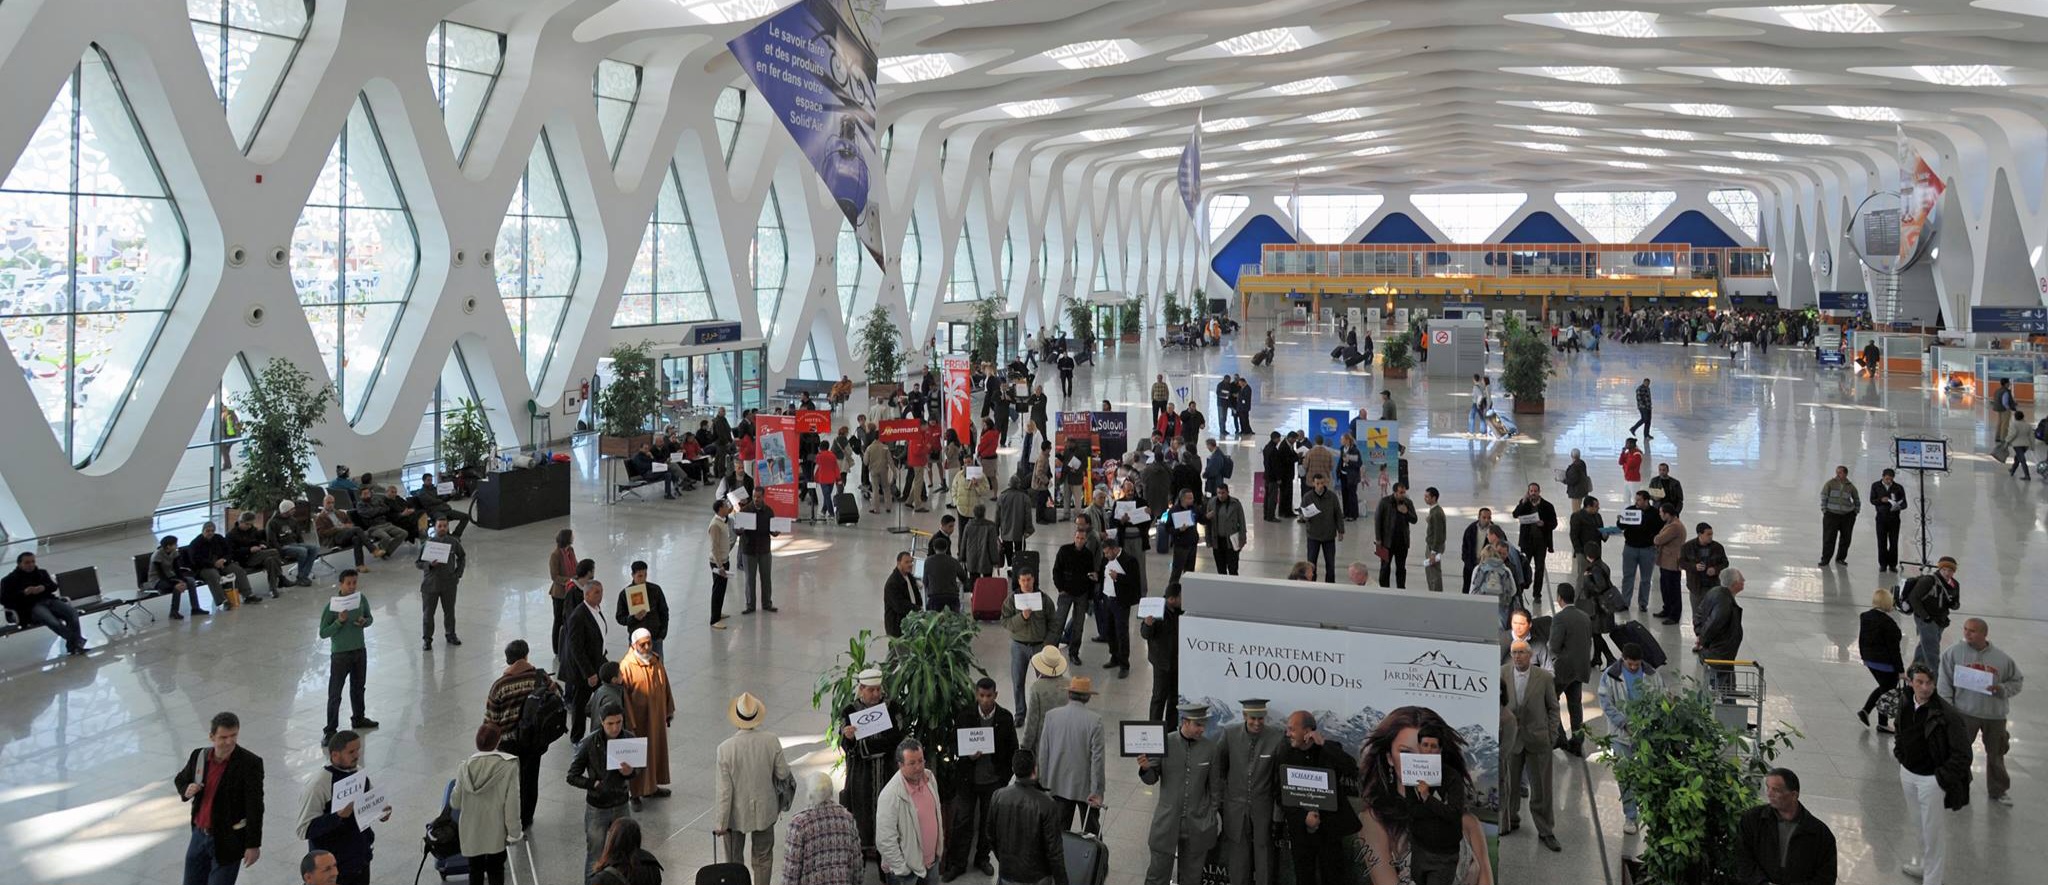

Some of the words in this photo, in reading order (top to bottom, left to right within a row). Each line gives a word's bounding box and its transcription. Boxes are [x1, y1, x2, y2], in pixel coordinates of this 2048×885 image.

[769, 22, 780, 37] Le
[782, 30, 807, 49] savoir
[808, 40, 825, 57] faire
[764, 44, 774, 56] et
[775, 46, 790, 63] des
[792, 55, 825, 76] produits
[756, 61, 767, 74] en
[769, 63, 781, 79] fer
[782, 70, 802, 87] dans
[803, 79, 824, 94] votre
[796, 96, 823, 113] espace
[790, 111, 823, 131] Solid'Air
[944, 360, 969, 370] FRAM
[1187, 636, 1235, 655] VOTRE
[1240, 645, 1345, 664] APPARTEMENT
[1224, 657, 1239, 678] À
[1245, 660, 1326, 686] 100.000
[1384, 669, 1424, 682] JARDINS
[1423, 668, 1488, 693] ATLAS
